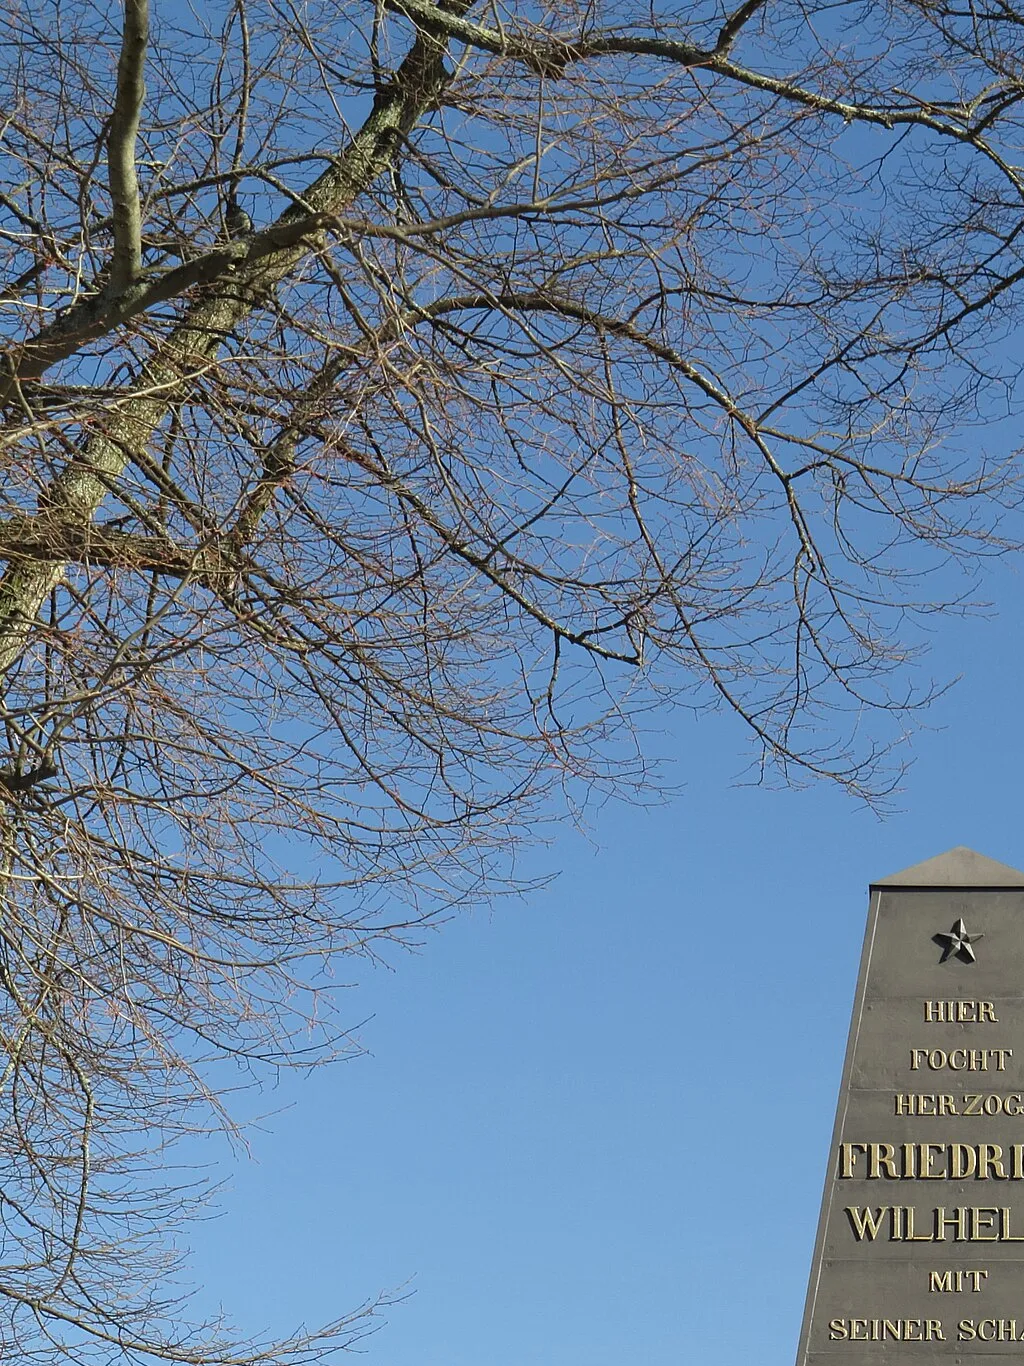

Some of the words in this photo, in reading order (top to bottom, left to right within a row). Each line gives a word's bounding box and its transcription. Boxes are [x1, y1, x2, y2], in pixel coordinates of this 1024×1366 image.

[924, 1001, 999, 1022] HIER
[911, 1049, 1013, 1070] FOCHT
[895, 1094, 1024, 1116] HERZOG
[929, 1270, 988, 1292] MIT
[829, 1319, 946, 1341] SEINER
